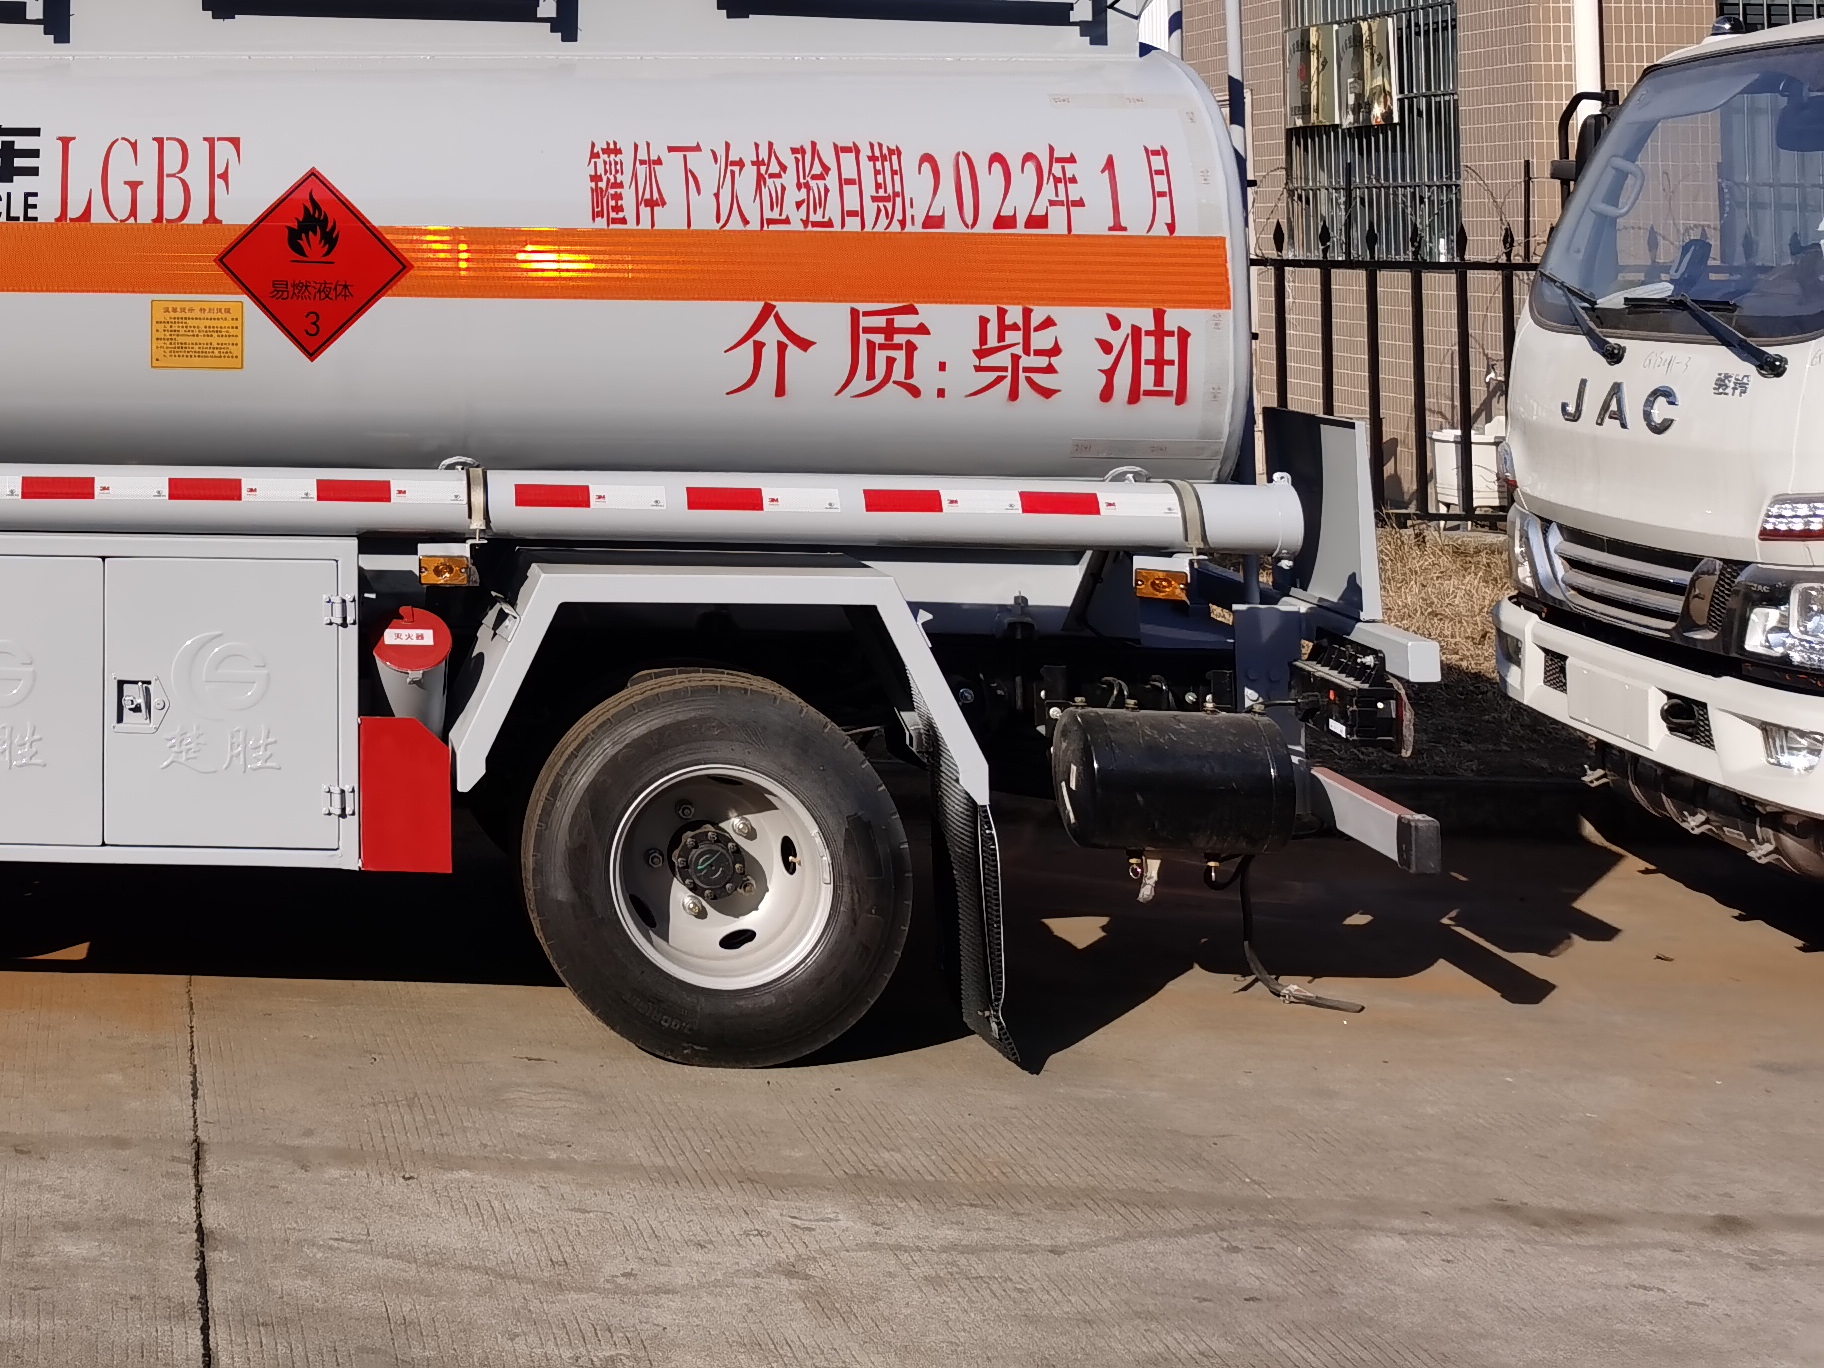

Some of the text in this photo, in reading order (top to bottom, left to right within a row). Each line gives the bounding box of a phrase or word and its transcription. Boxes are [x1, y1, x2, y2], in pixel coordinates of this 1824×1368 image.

[54, 136, 242, 224] LGBF
[270, 279, 354, 302] 易燃液体
[304, 311, 321, 337] 3
[1561, 378, 1680, 435] JAC
[394, 632, 425, 641] 灭火器
[159, 723, 282, 775] 楚胜
